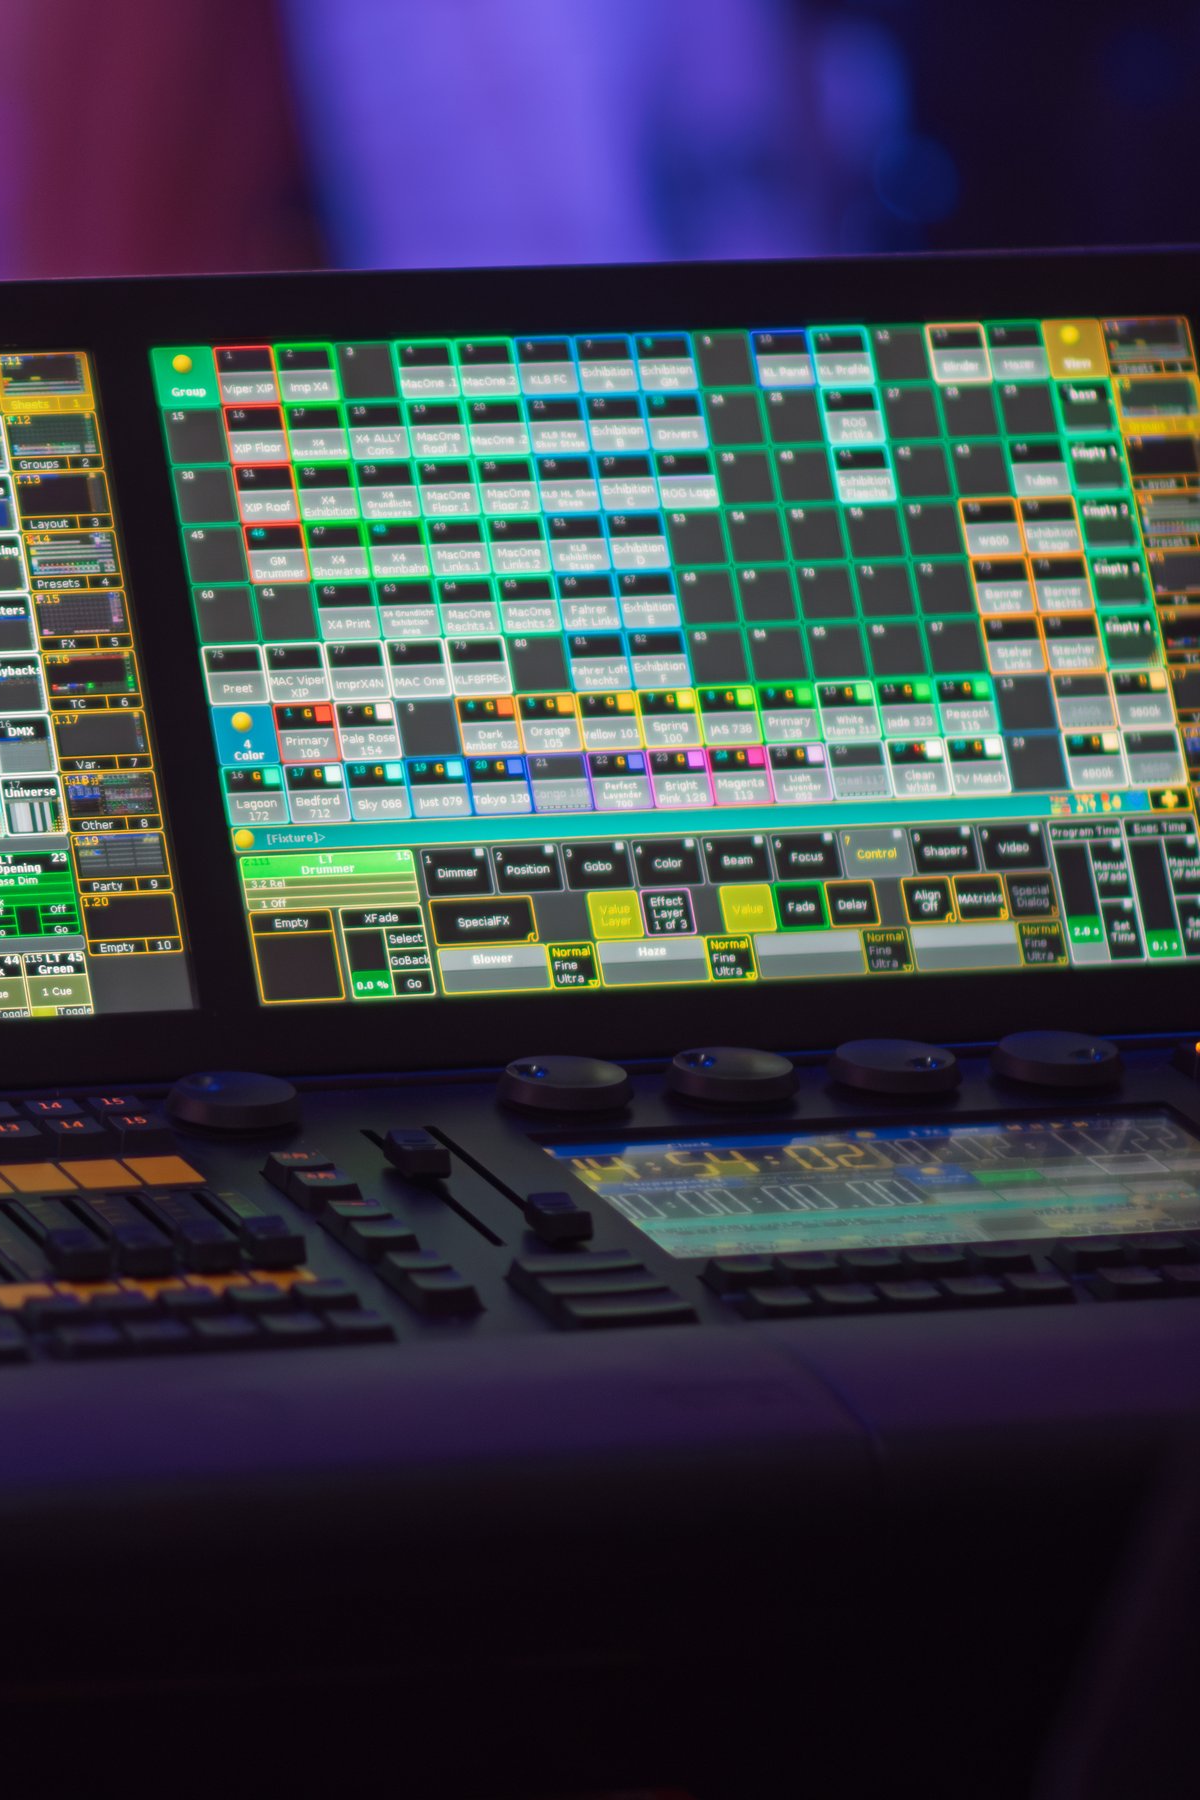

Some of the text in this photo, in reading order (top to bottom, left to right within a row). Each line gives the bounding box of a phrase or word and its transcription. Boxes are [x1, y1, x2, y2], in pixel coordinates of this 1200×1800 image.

[171, 387, 206, 399] Group
[223, 383, 274, 396] Viper XIP
[290, 381, 328, 394] Imp X4
[234, 442, 281, 454] XIP Floor
[19, 458, 60, 471] Groups
[245, 501, 291, 513] XIP Roof
[29, 518, 69, 531] Layout
[270, 556, 287, 566] GM
[255, 567, 304, 580] Drummer
[374, 562, 428, 574] Rennbahn
[37, 578, 81, 589] Presets
[61, 638, 76, 648] FX
[54, 715, 79, 725] 1.17
[8, 726, 34, 737] DMX
[285, 735, 329, 748] Primary
[75, 759, 101, 770] Var.
[4, 786, 57, 798] Universe
[236, 797, 278, 811] Lagoon
[81, 820, 113, 831] Other
[856, 847, 898, 860] Control
[997, 842, 1030, 855] Video
[653, 857, 683, 869] Color
[722, 854, 754, 867] Beam
[790, 851, 825, 864] Focus
[506, 864, 551, 877] Position
[583, 860, 613, 872] Gobo
[437, 867, 478, 879] Dimmer
[17, 876, 39, 885] Dim
[92, 880, 123, 892] Party
[83, 897, 109, 908] 1.20
[274, 917, 309, 930] Empty
[364, 912, 399, 924] XFade
[457, 915, 511, 930] SpecialFX
[389, 932, 424, 945] Select
[99, 942, 135, 954] Empty
[551, 945, 591, 958] Normal
[637, 945, 667, 957] Haze
[472, 953, 514, 965] Blower
[38, 964, 74, 975] Green
[38, 1101, 63, 1111] 14
